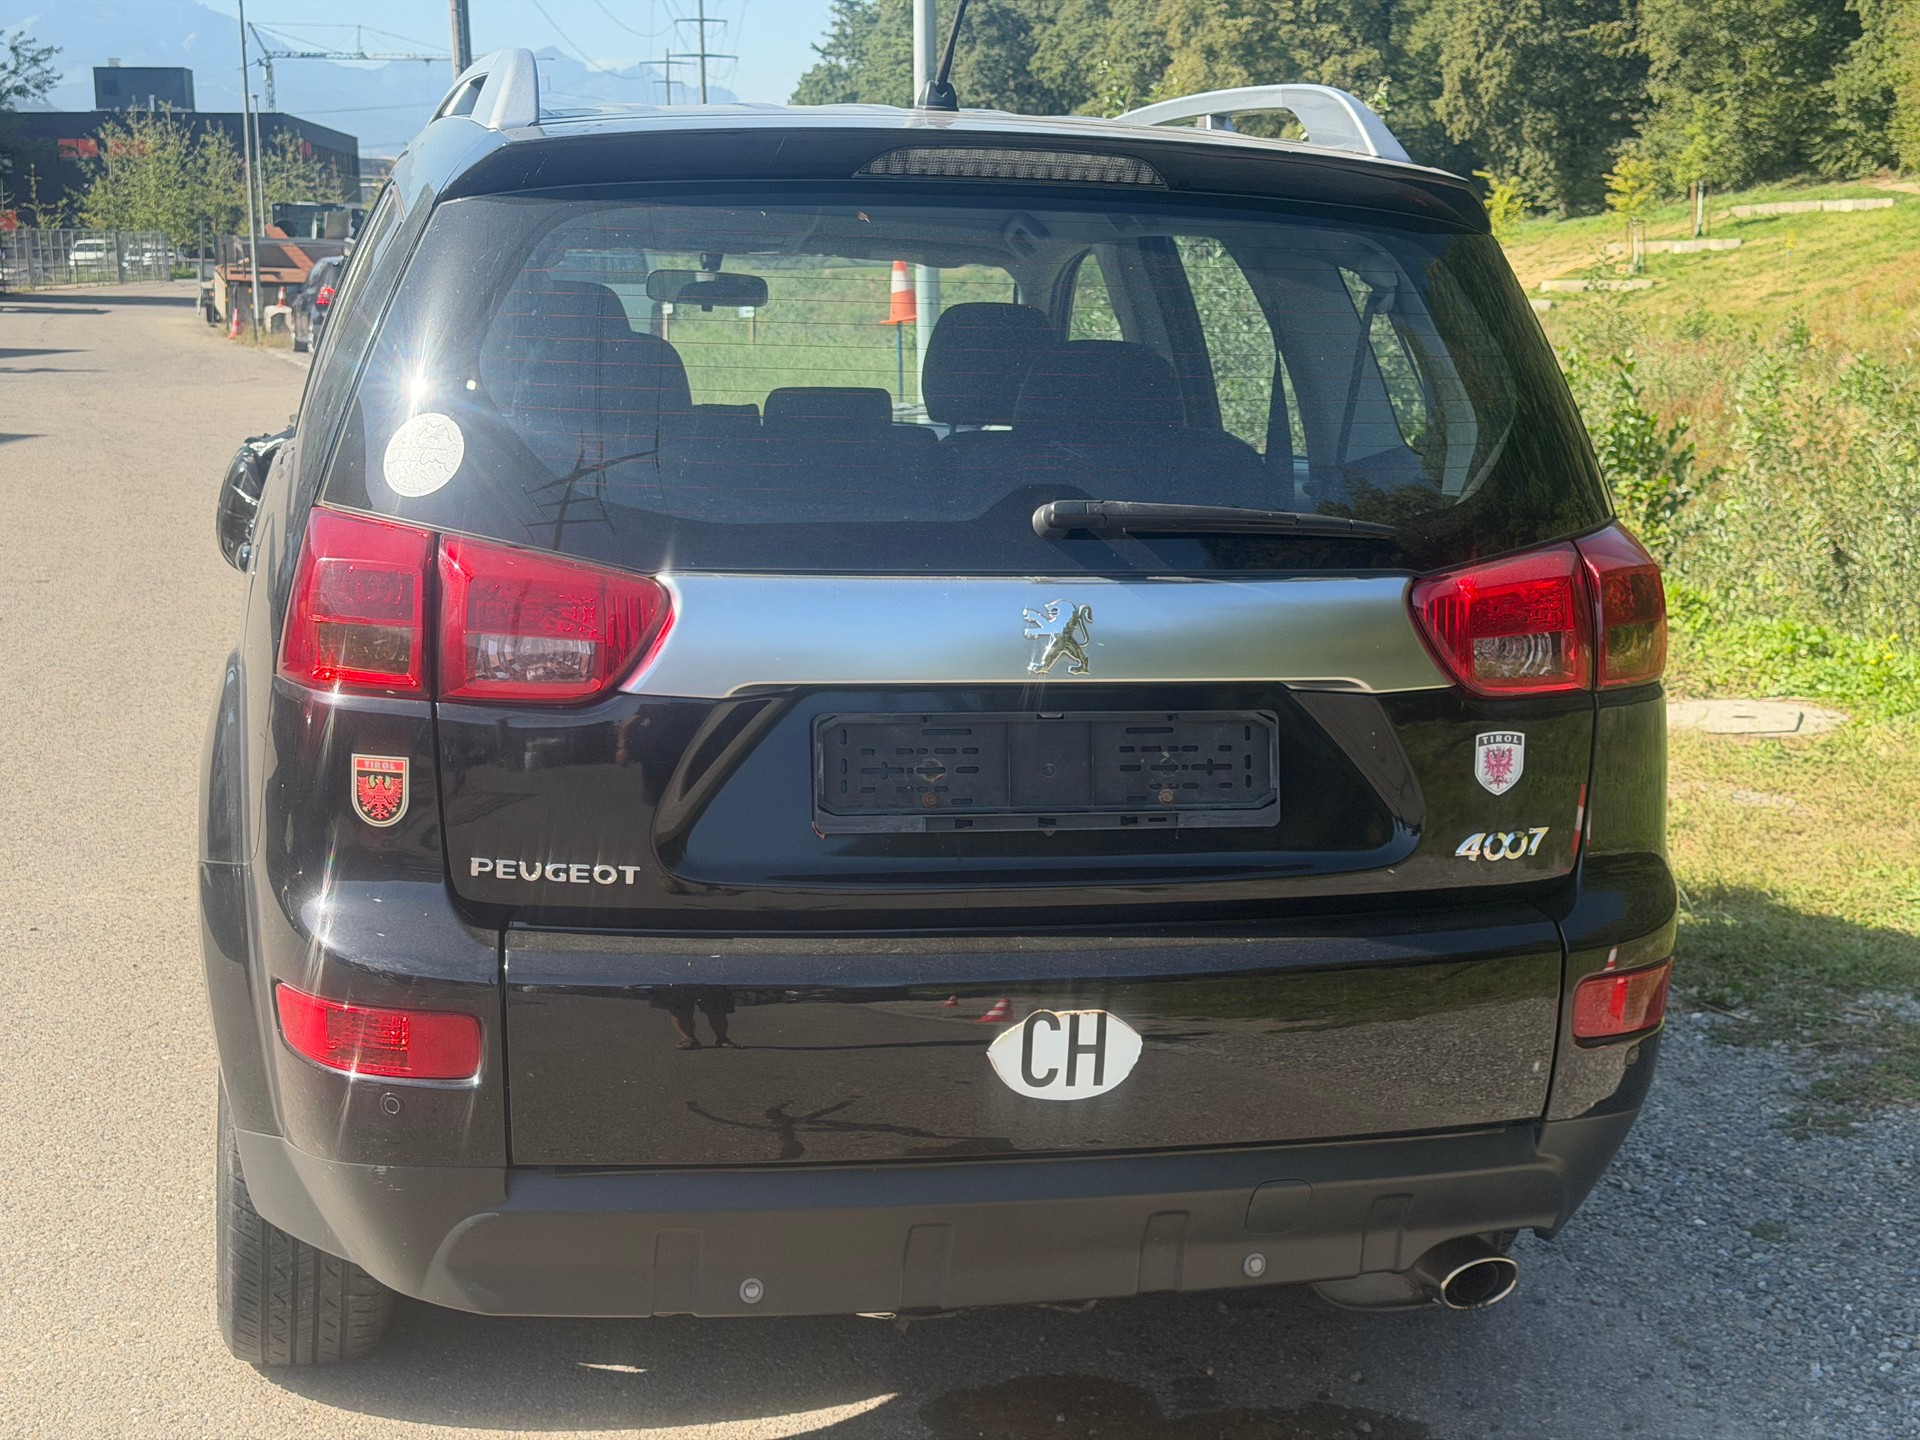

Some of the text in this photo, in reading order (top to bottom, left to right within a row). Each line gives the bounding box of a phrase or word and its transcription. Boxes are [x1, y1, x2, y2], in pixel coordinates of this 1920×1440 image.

[1482, 734, 1520, 744] TIROL
[364, 761, 396, 770] TIROL
[1454, 826, 1550, 862] 4007
[470, 857, 641, 885] PEUGEOT
[1021, 1011, 1107, 1088] CH
